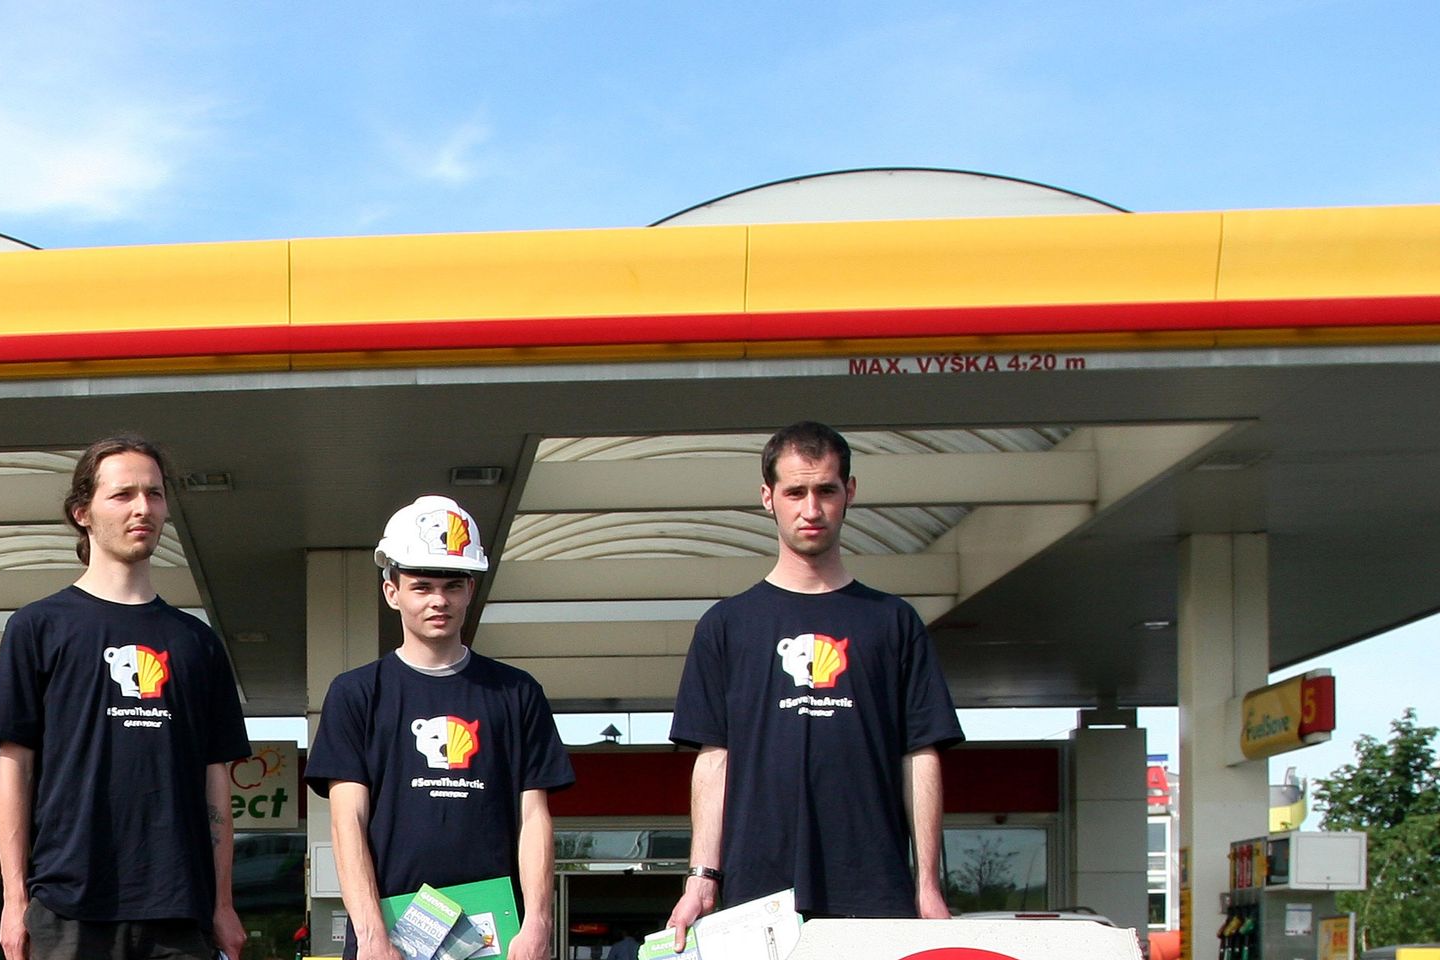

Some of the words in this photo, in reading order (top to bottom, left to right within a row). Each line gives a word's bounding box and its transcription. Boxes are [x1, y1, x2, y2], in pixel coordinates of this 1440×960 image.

[848, 357, 908, 375] MAX.
[915, 352, 1000, 373] VÝŠKA
[1065, 356, 1086, 369] m
[1304, 688, 1316, 724] 5
[411, 777, 485, 790] #SaveTheArctic
